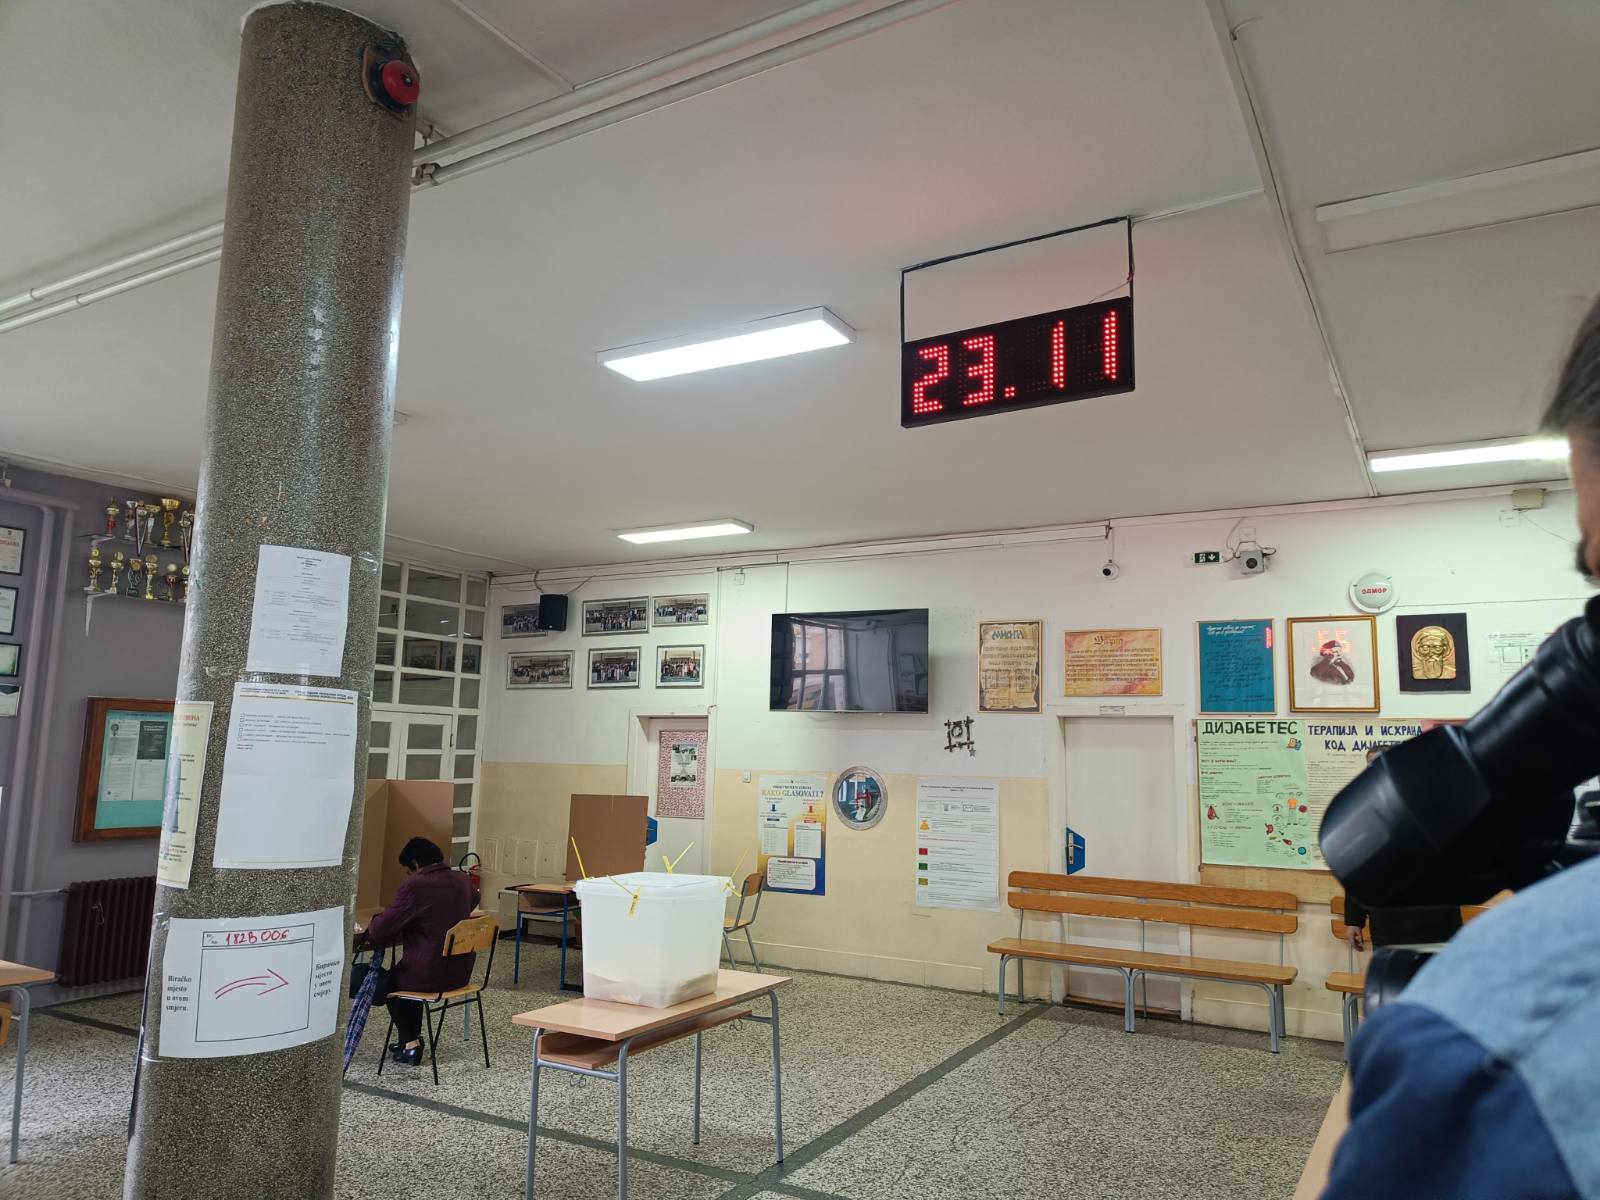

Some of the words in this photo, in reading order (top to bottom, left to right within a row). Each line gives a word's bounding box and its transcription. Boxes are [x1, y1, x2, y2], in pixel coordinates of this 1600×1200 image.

[1361, 587, 1388, 595] ОДМОР
[1202, 721, 1298, 735] ДИЈАБЕТЕС
[1307, 725, 1358, 736] ТЕРАПИЈА
[1365, 725, 1374, 736] И
[1325, 740, 1346, 752] КОД
